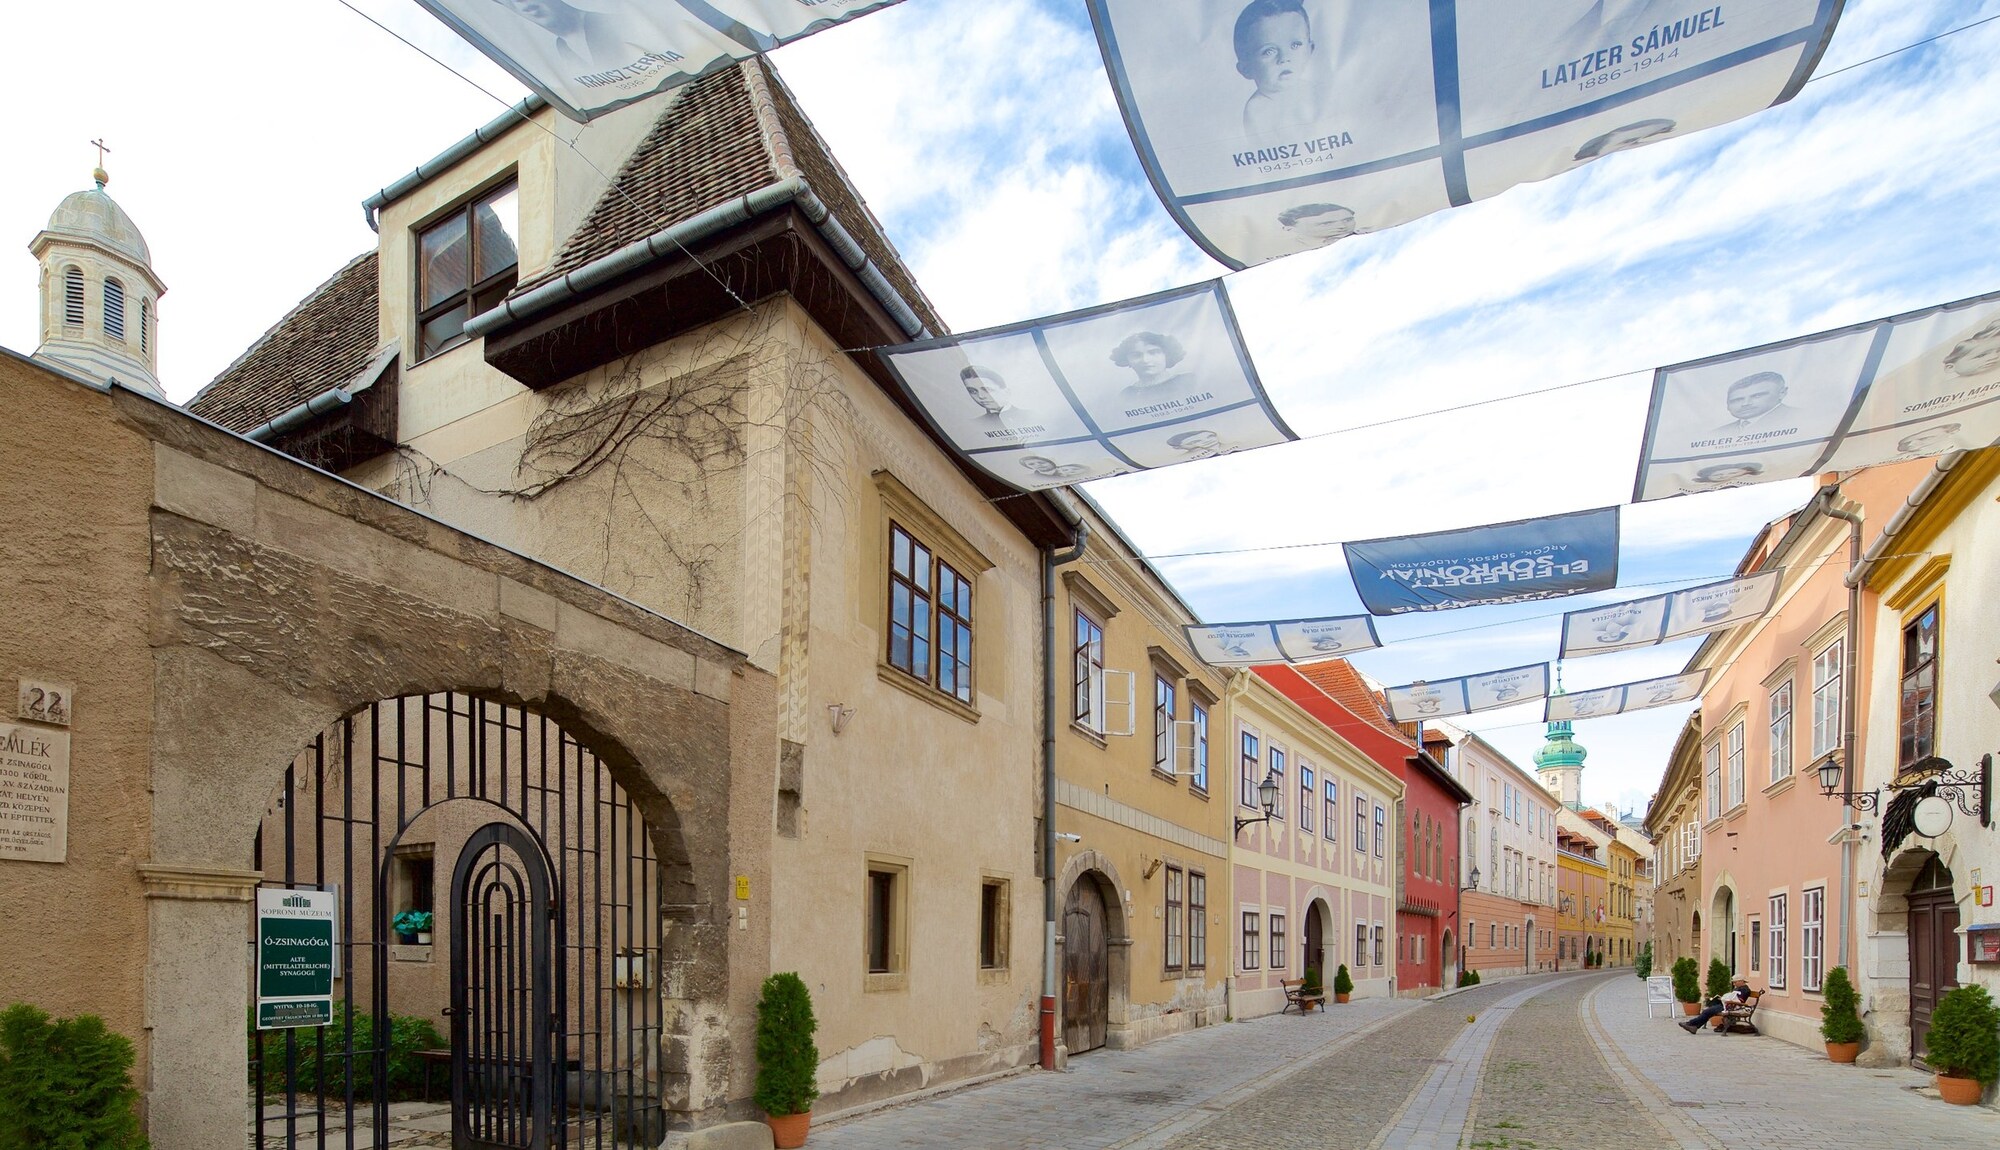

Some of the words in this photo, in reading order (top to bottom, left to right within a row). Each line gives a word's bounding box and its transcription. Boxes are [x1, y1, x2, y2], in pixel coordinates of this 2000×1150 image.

[1542, 45, 1622, 89] LATZER
[1630, 6, 1725, 58] SÁMUEL
[574, 69, 632, 88] KRAUSZ
[1578, 47, 1679, 92] 1886-1944
[1233, 143, 1301, 167] KRAUSZ
[1304, 131, 1353, 154] VERA
[1258, 153, 1334, 174] 1943-1944
[1125, 399, 1184, 418] ROSENTHAL
[1185, 391, 1214, 405] JÚLIA
[1903, 391, 1965, 414] SOMOGYI
[984, 428, 1018, 439] WEILER
[1019, 424, 1046, 435] ERVIN
[1690, 437, 1733, 449] WEILER
[1736, 427, 1798, 443] ZSIGMOND
[30, 687, 62, 715] 22
[260, 908, 296, 916] SOPRONI
[264, 935, 329, 946] Ó-ZSINAGÓGA
